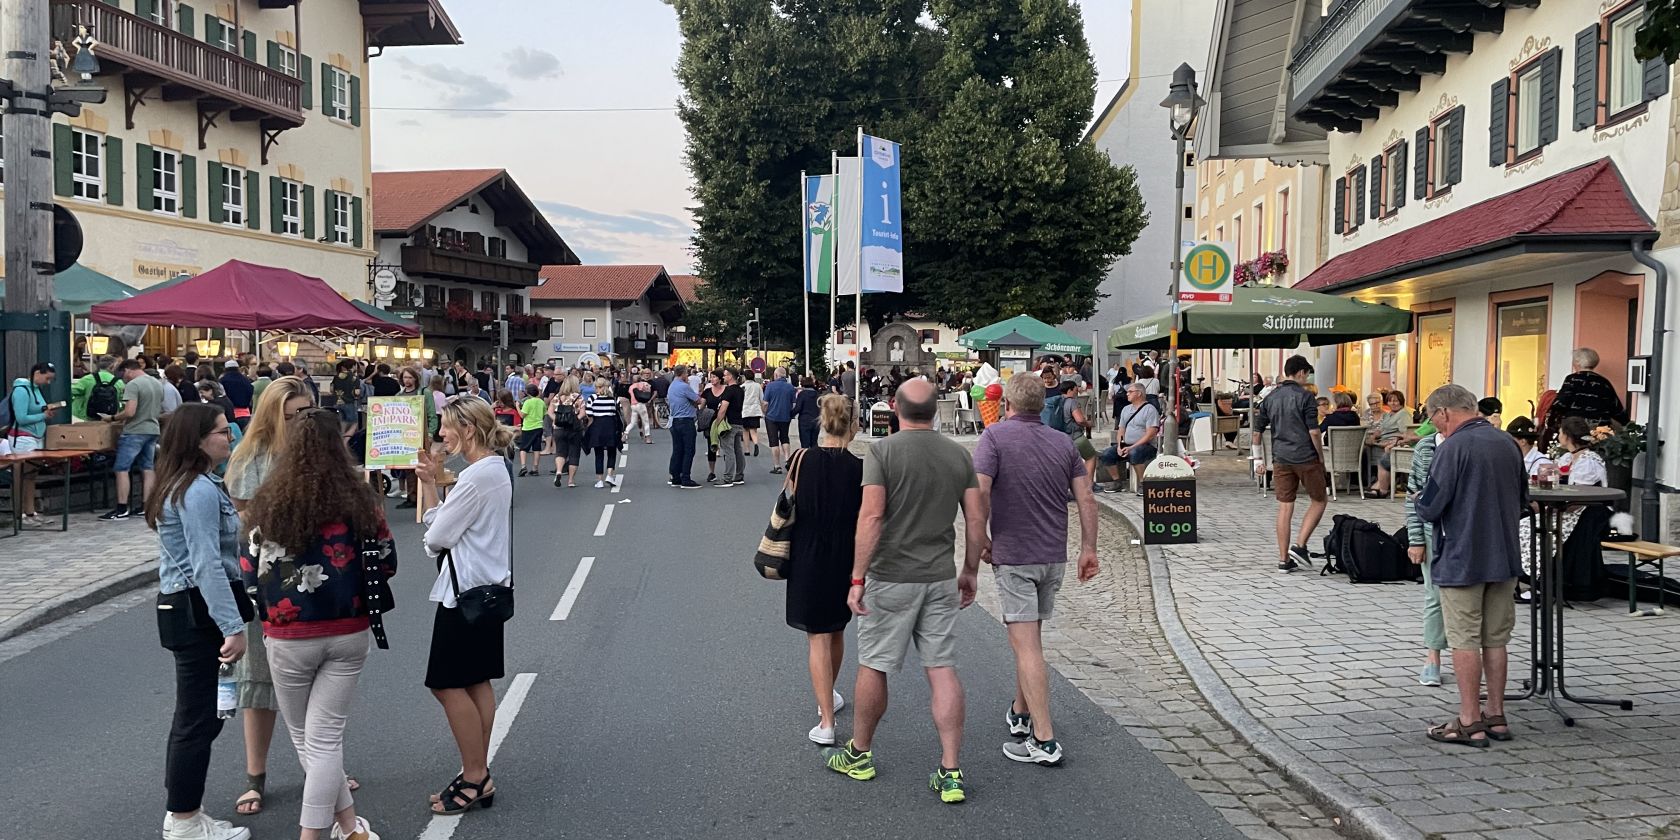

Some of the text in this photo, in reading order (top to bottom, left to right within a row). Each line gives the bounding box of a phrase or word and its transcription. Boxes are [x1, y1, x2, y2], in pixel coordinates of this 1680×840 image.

[138, 264, 167, 279] Gasthof
[1198, 254, 1217, 280] H
[1262, 315, 1335, 332] Schönramer
[1044, 343, 1082, 353] Schönramer
[384, 407, 410, 416] KINO
[373, 415, 416, 425] IM PARK
[1148, 488, 1191, 499] Koffee
[1148, 503, 1192, 514] Kuchen
[1149, 521, 1192, 537] to go
